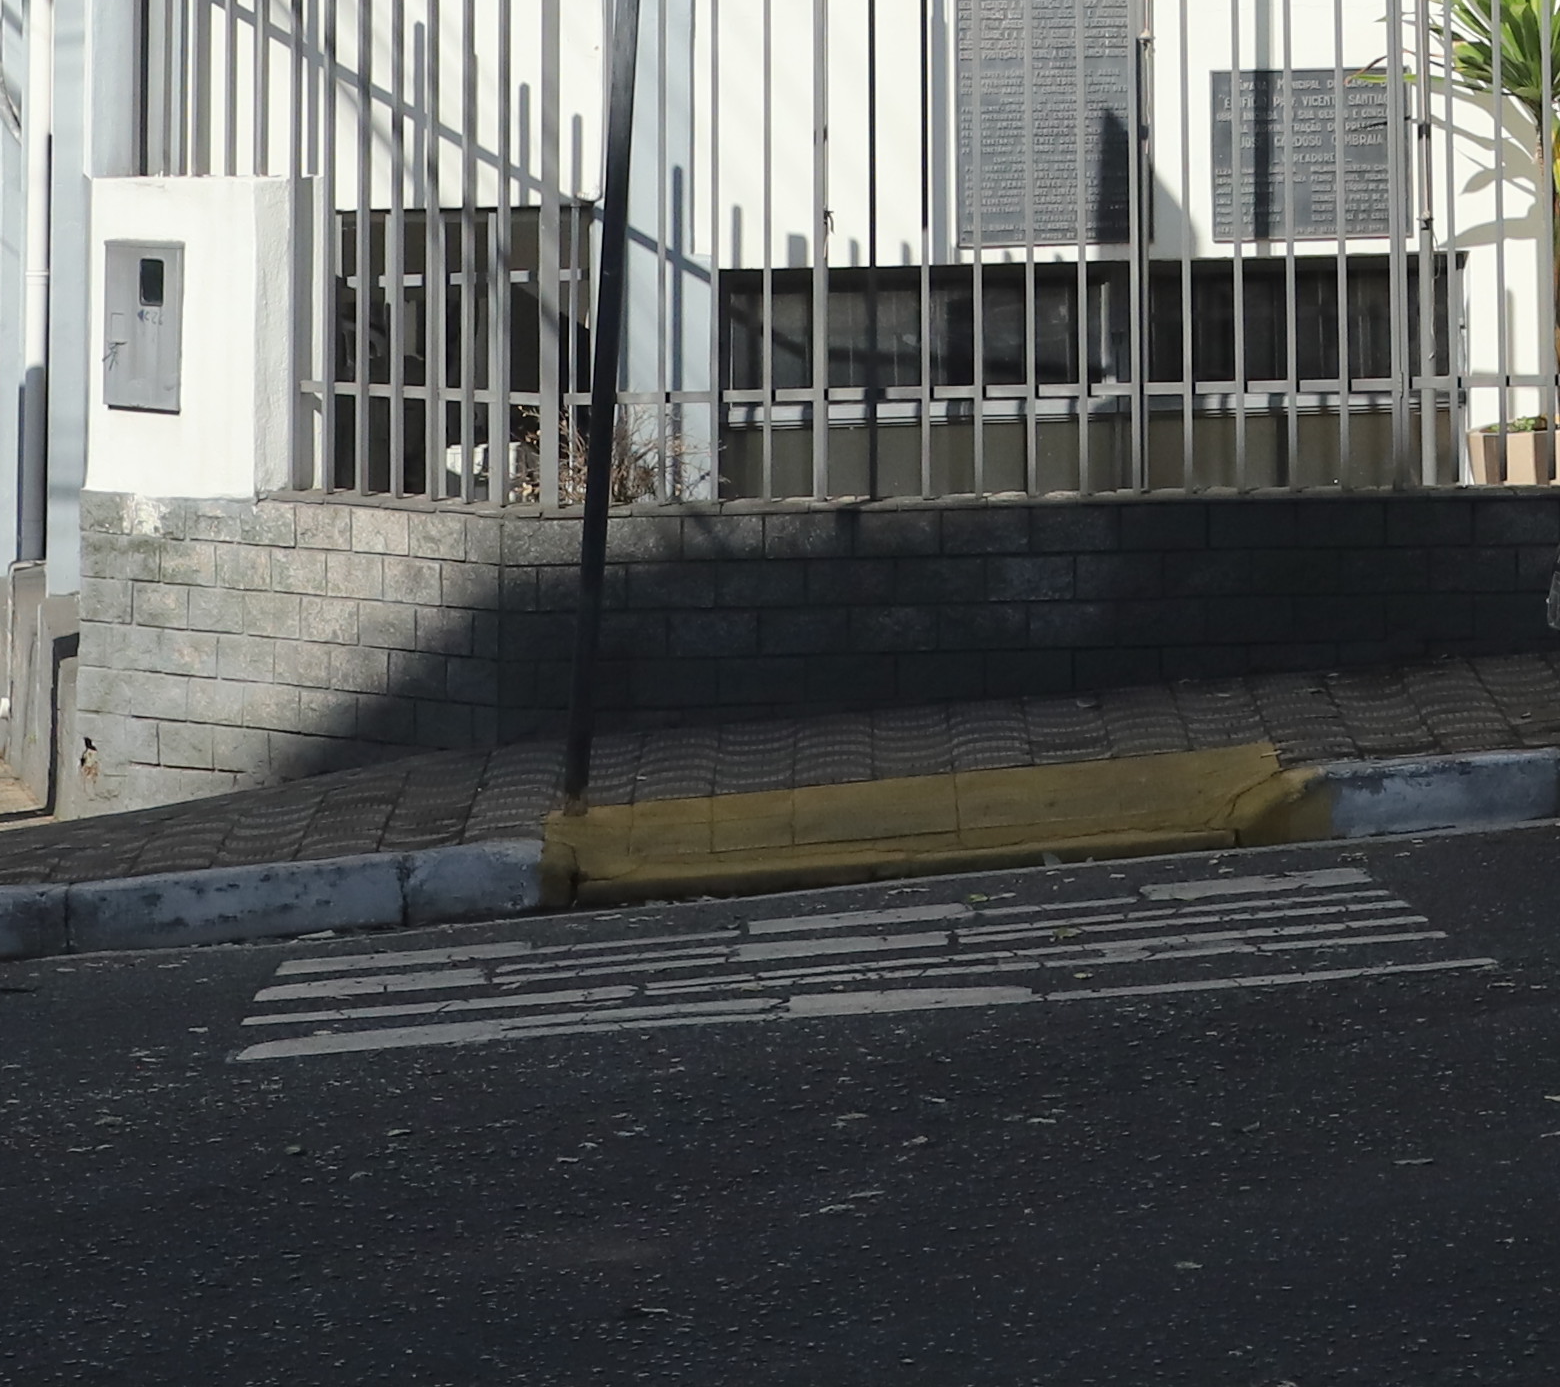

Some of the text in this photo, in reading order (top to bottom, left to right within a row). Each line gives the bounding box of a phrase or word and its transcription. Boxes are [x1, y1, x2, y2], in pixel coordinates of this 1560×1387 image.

[1277, 78, 1321, 90] MNICIPAL
[1302, 94, 1336, 106] VICENT
[1274, 137, 1322, 148] CADOSO
[1331, 135, 1383, 147] CMBRAIA
